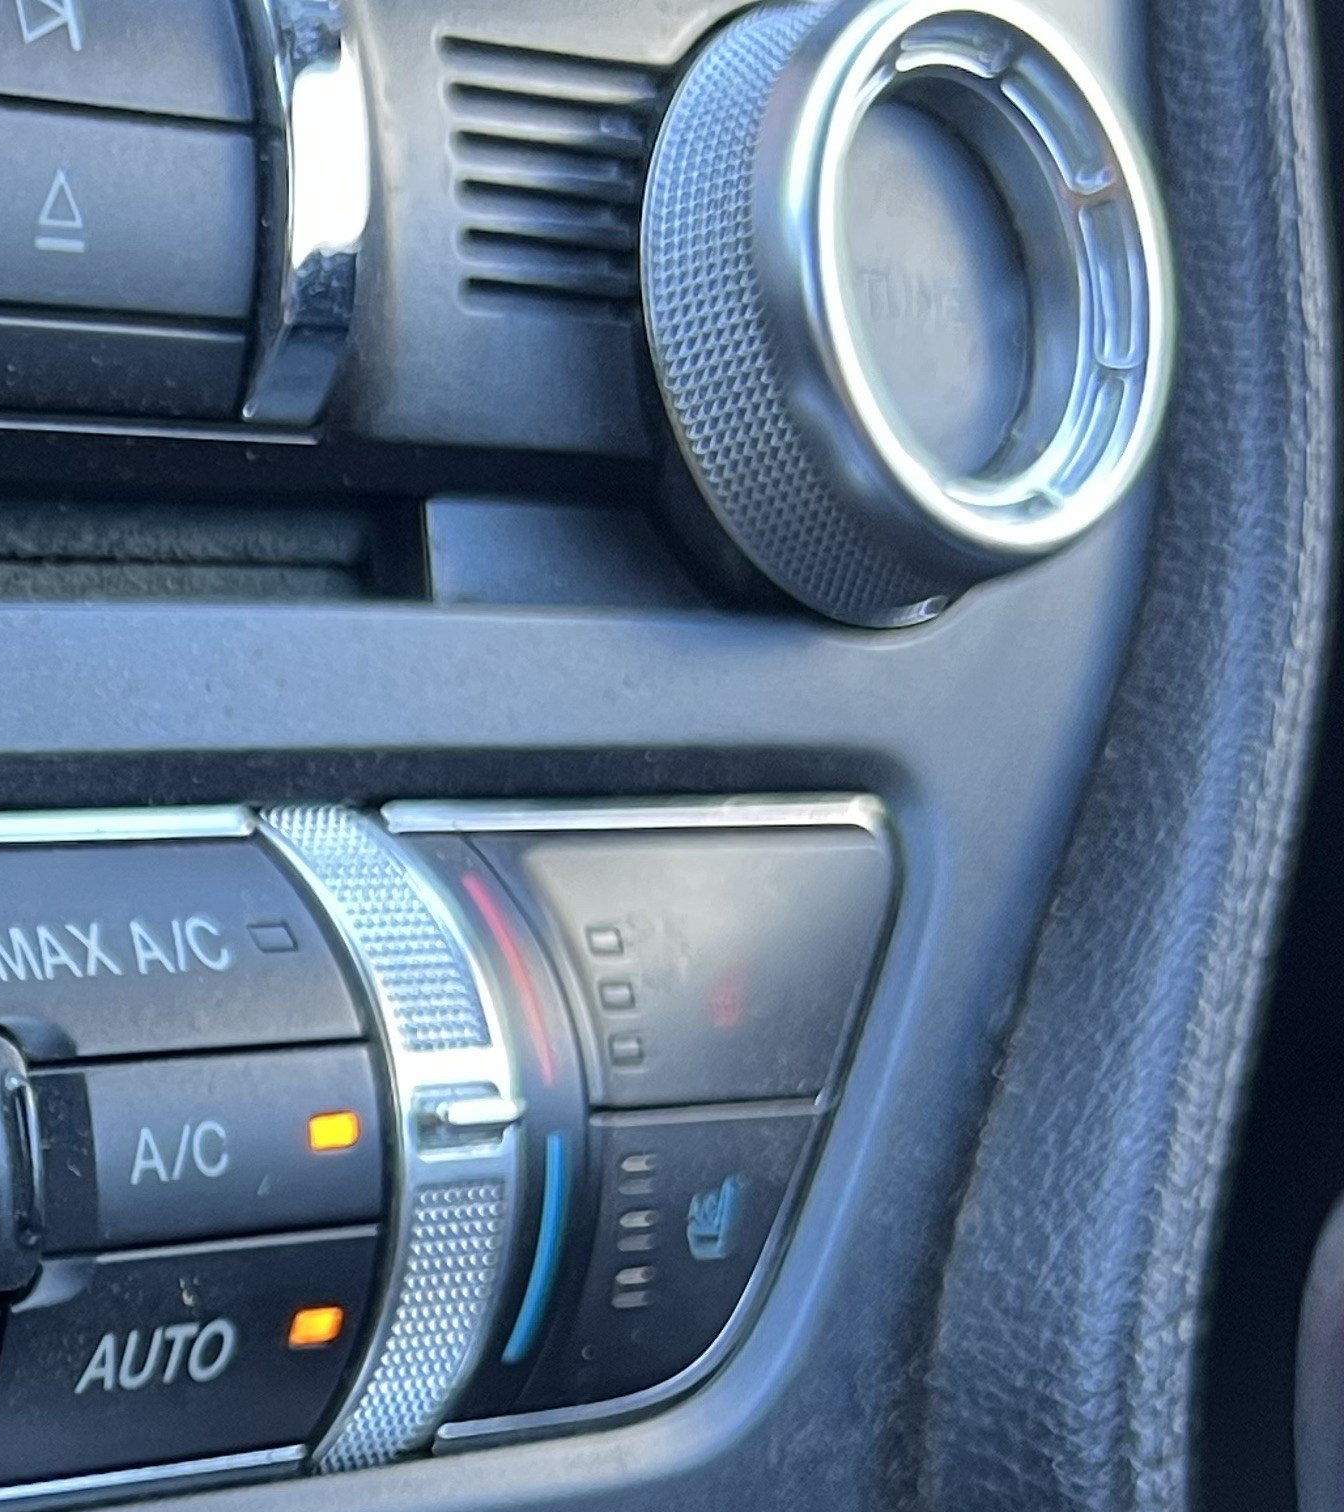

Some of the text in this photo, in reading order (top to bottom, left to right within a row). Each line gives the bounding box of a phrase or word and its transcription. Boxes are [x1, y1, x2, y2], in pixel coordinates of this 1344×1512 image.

[130, 917, 230, 978] A/C
[130, 1120, 229, 1185] A/C
[73, 1318, 238, 1394] AUTO
